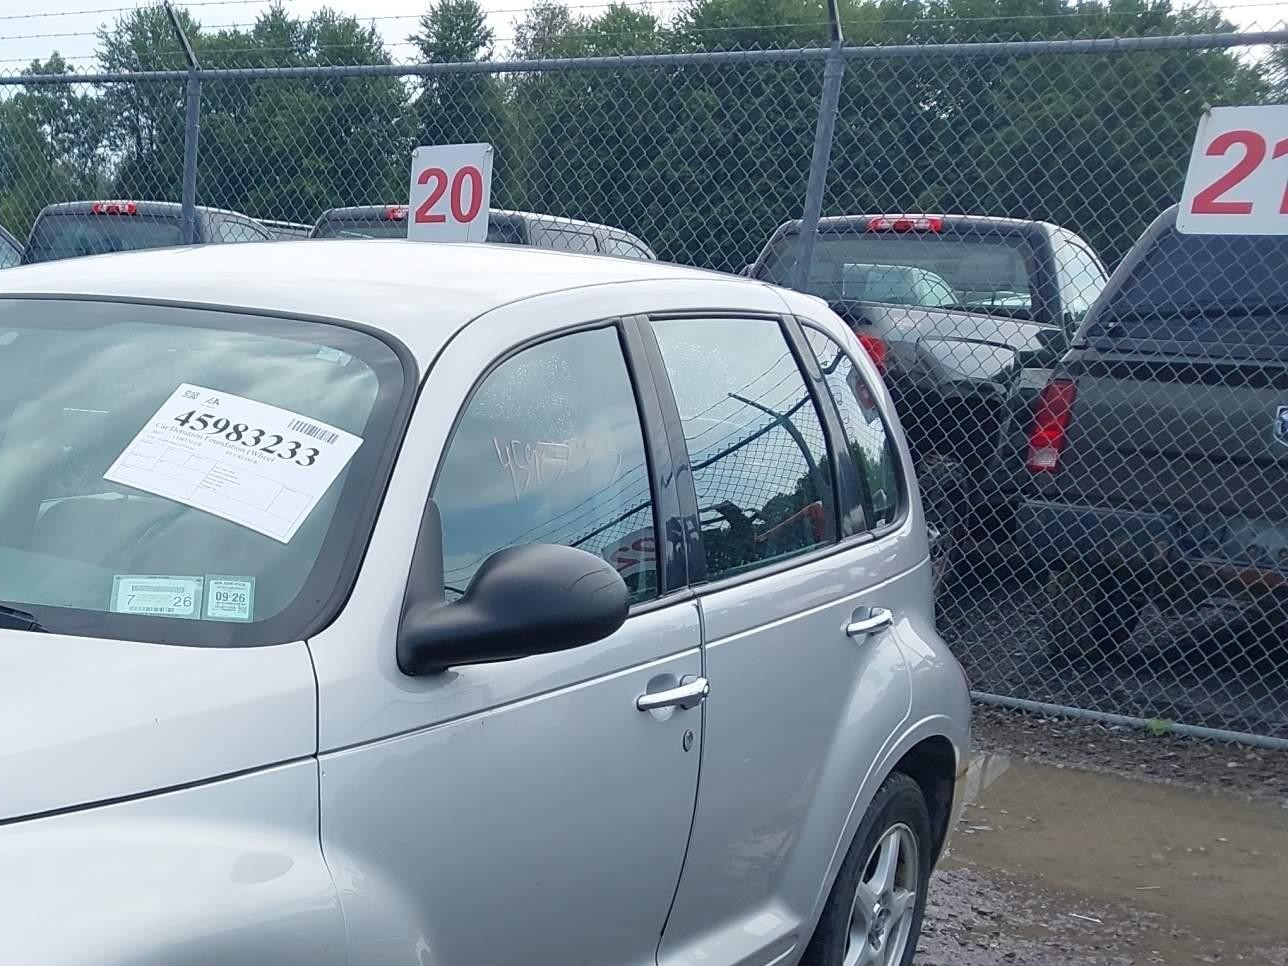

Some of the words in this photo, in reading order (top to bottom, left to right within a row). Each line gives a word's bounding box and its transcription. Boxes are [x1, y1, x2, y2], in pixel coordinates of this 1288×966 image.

[414, 165, 483, 224] 20
[173, 409, 320, 467] 45983233
[173, 596, 192, 607] 26
[215, 591, 229, 602] 09
[231, 592, 246, 603] 26
